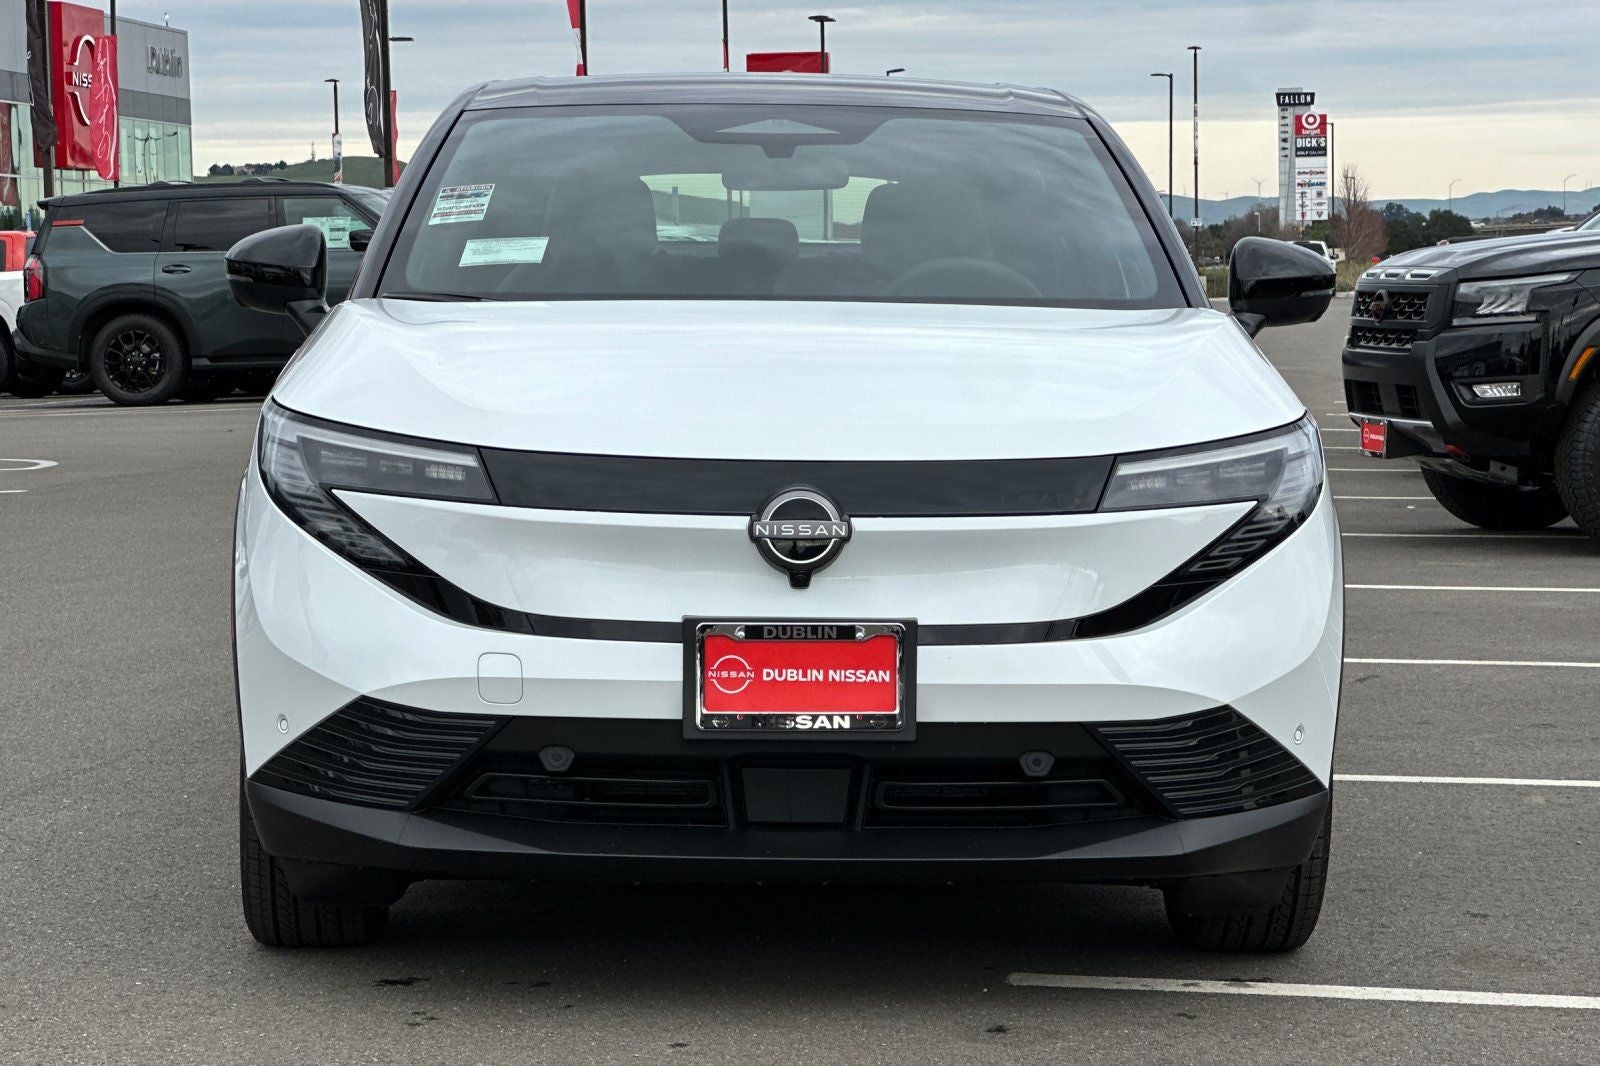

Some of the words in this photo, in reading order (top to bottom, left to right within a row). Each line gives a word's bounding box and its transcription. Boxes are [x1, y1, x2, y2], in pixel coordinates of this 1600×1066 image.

[146, 44, 183, 77] Dublin
[72, 71, 93, 87] NISS
[1280, 95, 1311, 104] FALLON
[1280, 107, 1289, 158] GATEWAY
[1296, 137, 1325, 147] DICK'S
[755, 524, 846, 536] NISSAN
[763, 626, 837, 639] DUBLIN
[708, 670, 755, 678] NISSAN
[762, 668, 823, 682] DUBLIN
[828, 669, 891, 683] NISSAN
